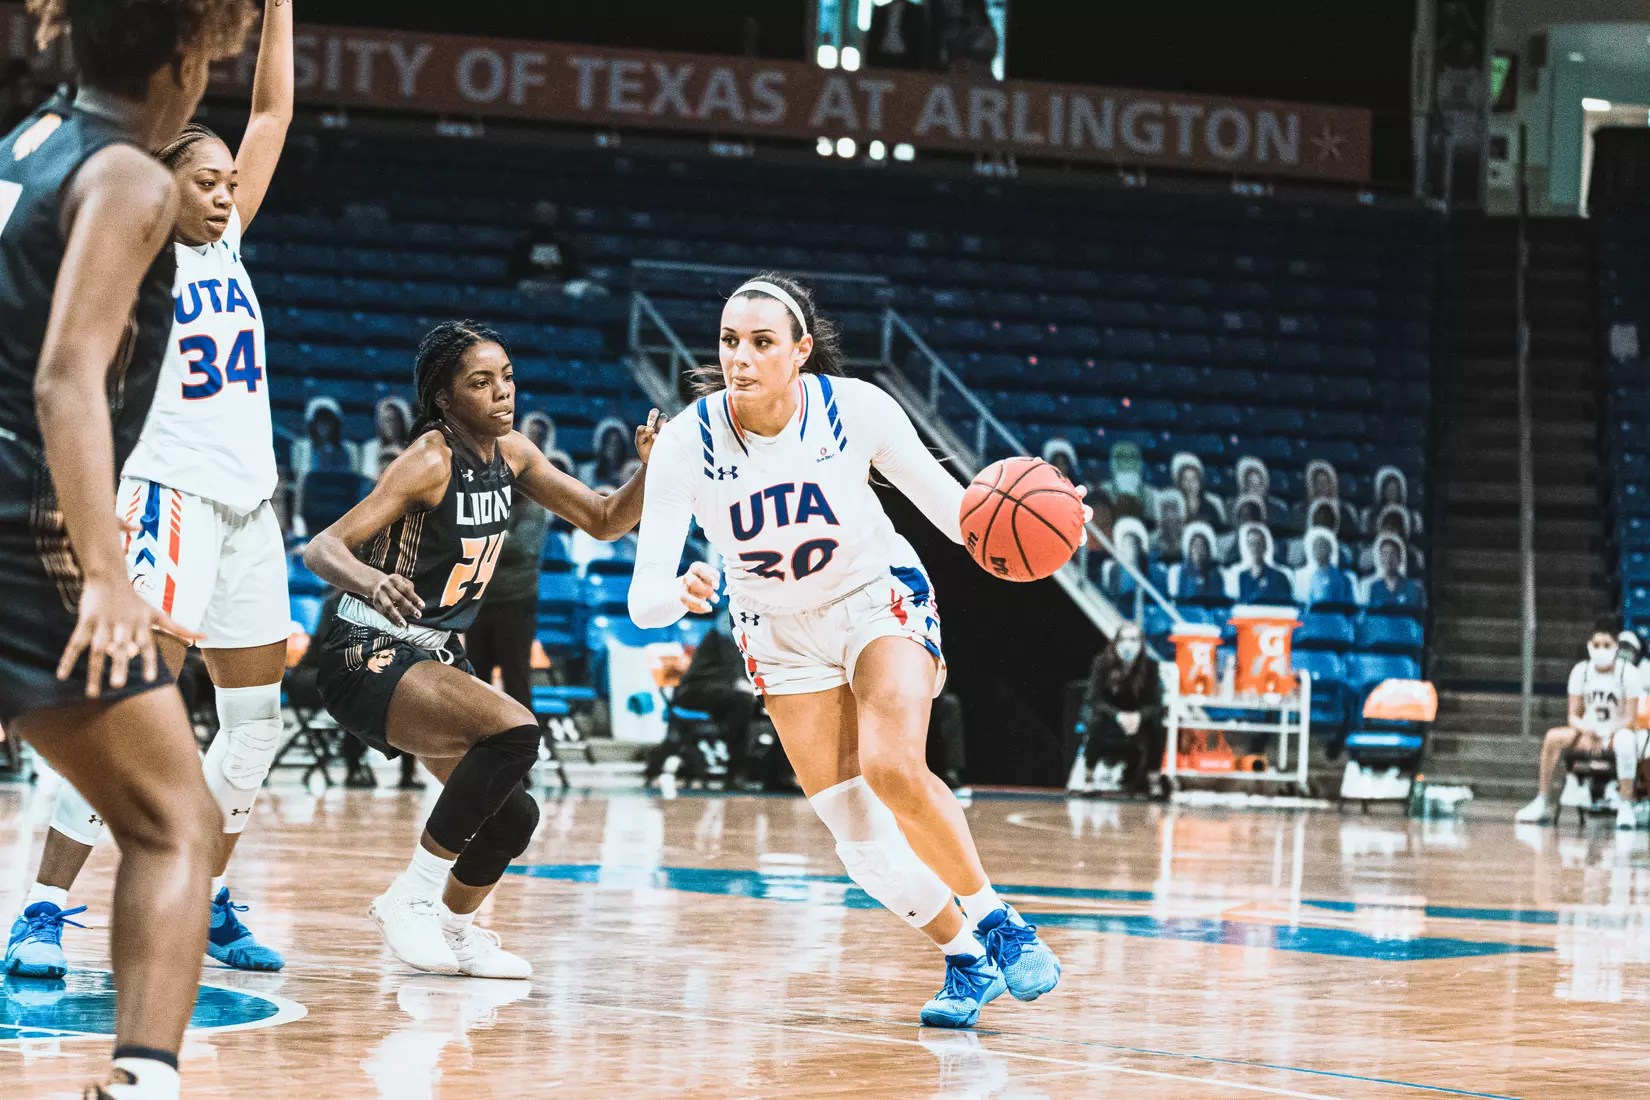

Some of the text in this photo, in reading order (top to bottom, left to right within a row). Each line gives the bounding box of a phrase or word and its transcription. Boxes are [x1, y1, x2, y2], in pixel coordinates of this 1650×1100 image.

[457, 48, 546, 104] OF
[569, 55, 787, 122] TEXAS
[810, 75, 895, 131] AT
[914, 84, 1298, 163] ARLINGTON
[174, 277, 256, 324] UTA
[178, 329, 262, 400] 34
[456, 484, 512, 526] LION
[729, 481, 840, 541] UTA
[439, 529, 508, 607] 24
[738, 537, 839, 582] 20
